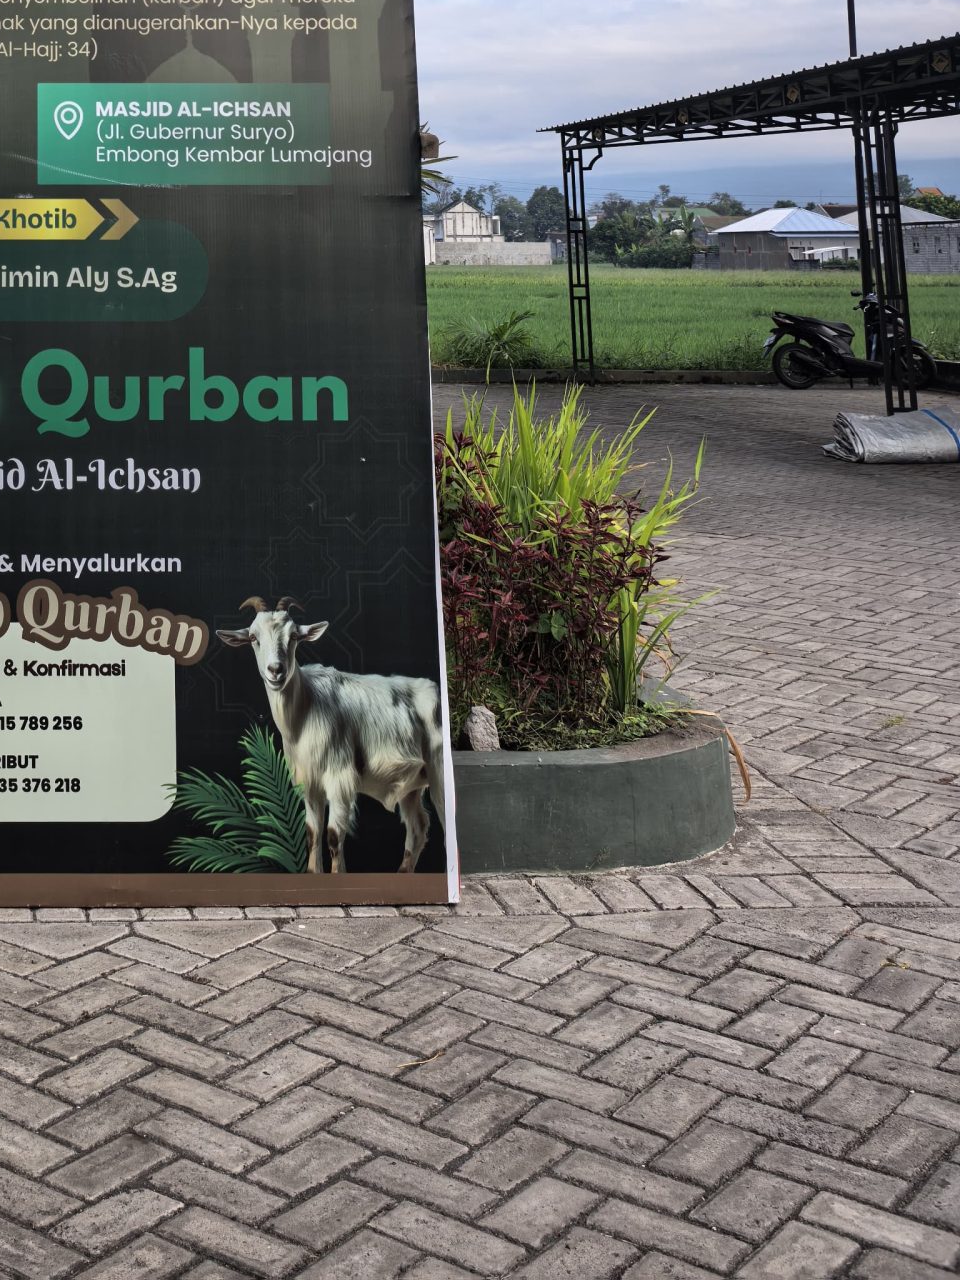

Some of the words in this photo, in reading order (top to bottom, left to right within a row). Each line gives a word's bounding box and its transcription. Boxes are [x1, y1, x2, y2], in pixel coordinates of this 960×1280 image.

[29, 17, 78, 36] yang
[83, 14, 278, 36] dianugerahkan-Nya
[283, 13, 358, 35] kepada
[67, 37, 98, 61] 34)
[95, 101, 173, 117] MASJID
[177, 101, 291, 117] AL-ICHSAN
[96, 119, 124, 144] (Jl.
[129, 123, 225, 140] Gubernur
[230, 119, 295, 145] Suryo)
[96, 145, 179, 168] Embong
[185, 145, 265, 163] Kembar
[271, 145, 372, 168] Lumajang
[66, 265, 109, 293] Aly
[117, 267, 178, 293] S.Ag
[20, 346, 349, 438] Qurban
[31, 457, 201, 493] Al-Ichsan
[21, 553, 182, 579] Menyalurkan
[21, 584, 205, 660] Qurban
[3, 658, 18, 677] &
[23, 659, 126, 677] Konfirmasi
[19, 715, 49, 731] 789
[52, 715, 83, 731] 256
[21, 777, 51, 793] 376
[54, 777, 81, 793] 218
